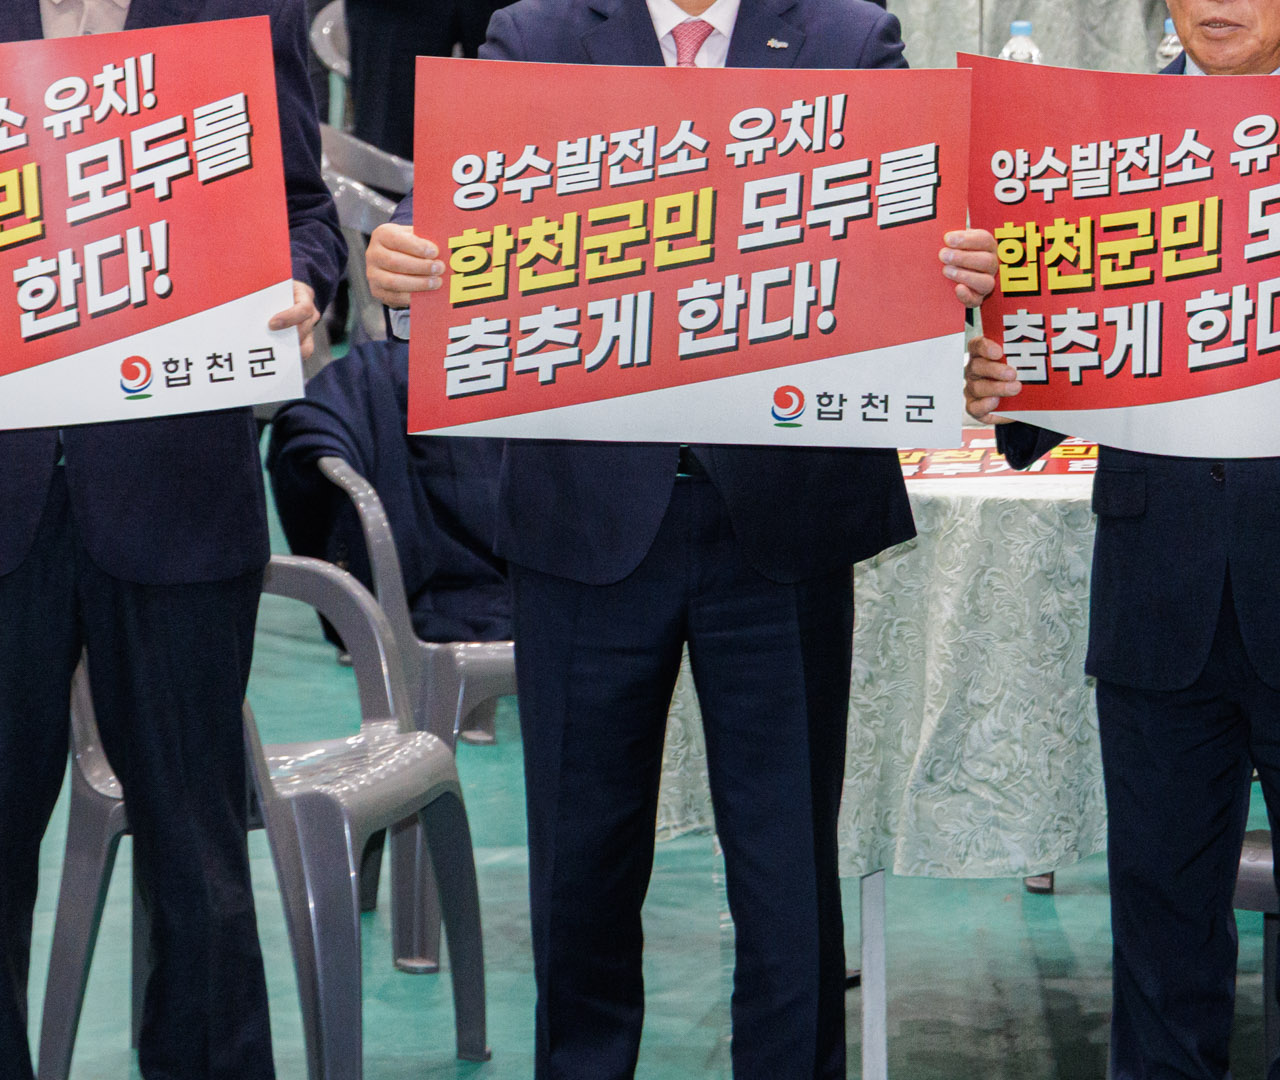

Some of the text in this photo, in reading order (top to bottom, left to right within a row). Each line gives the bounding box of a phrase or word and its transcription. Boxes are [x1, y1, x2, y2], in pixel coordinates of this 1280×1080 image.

[43, 52, 157, 139] 유치!
[65, 91, 252, 225] 모두를
[451, 93, 849, 211] 양수발전소 유치!
[990, 127, 1214, 205] 양수발전소
[448, 143, 940, 306] 합천군민 모두를
[993, 194, 1221, 295] 합천군민
[13, 219, 173, 341] 한다!
[443, 257, 839, 398] 춤추게 한다!
[161, 345, 278, 389] 합천군
[1001, 300, 1162, 383] 춤추게
[815, 391, 936, 424] 합천군
